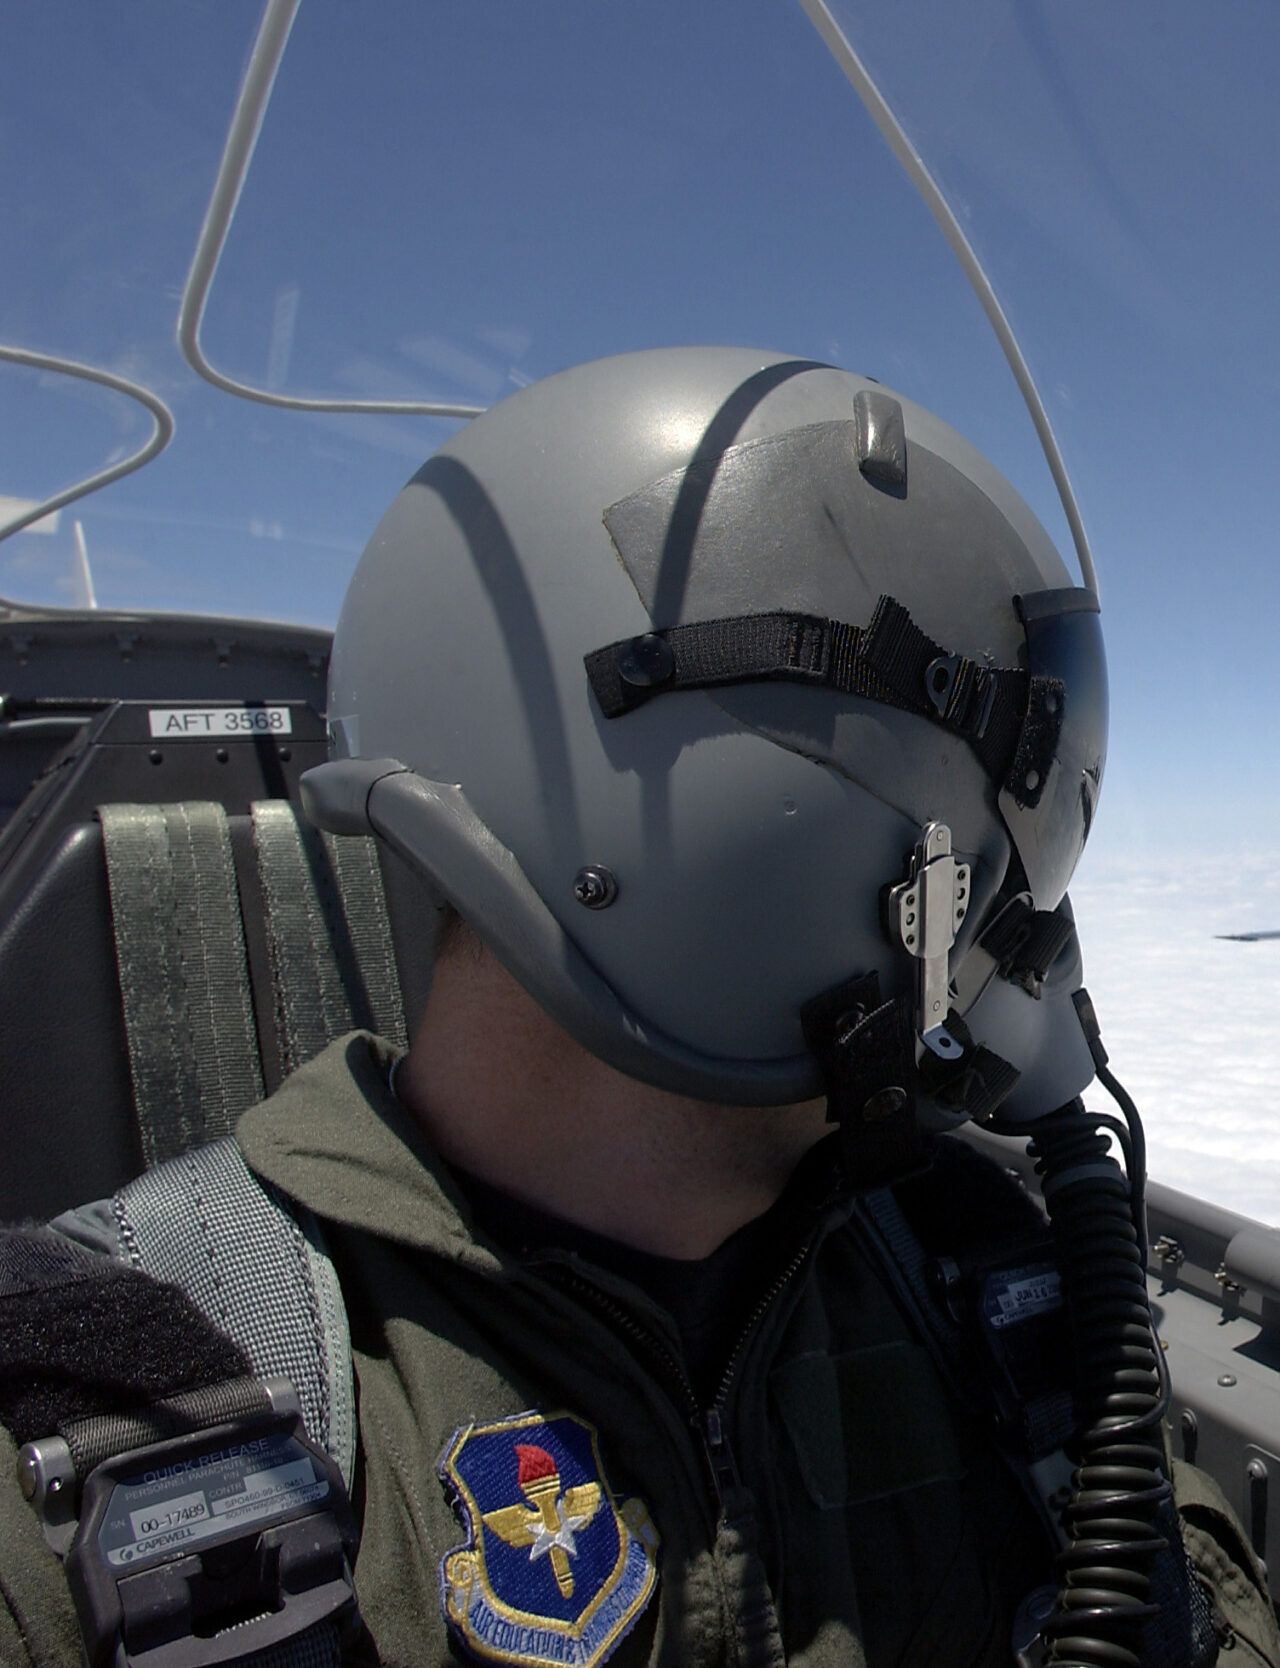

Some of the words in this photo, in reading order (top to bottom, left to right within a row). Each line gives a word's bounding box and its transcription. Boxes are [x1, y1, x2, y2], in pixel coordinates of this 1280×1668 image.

[166, 714, 216, 732] AFT
[224, 711, 284, 731] 3568
[143, 1459, 196, 1484] QUICK
[199, 1438, 269, 1467] RELEASE
[125, 1477, 186, 1501] PERSONNEL
[188, 1458, 246, 1483] PARACHUTE
[141, 1504, 205, 1534] 00-17489
[136, 1528, 195, 1554] CAPEWELL
[470, 1599, 495, 1639] AIR
